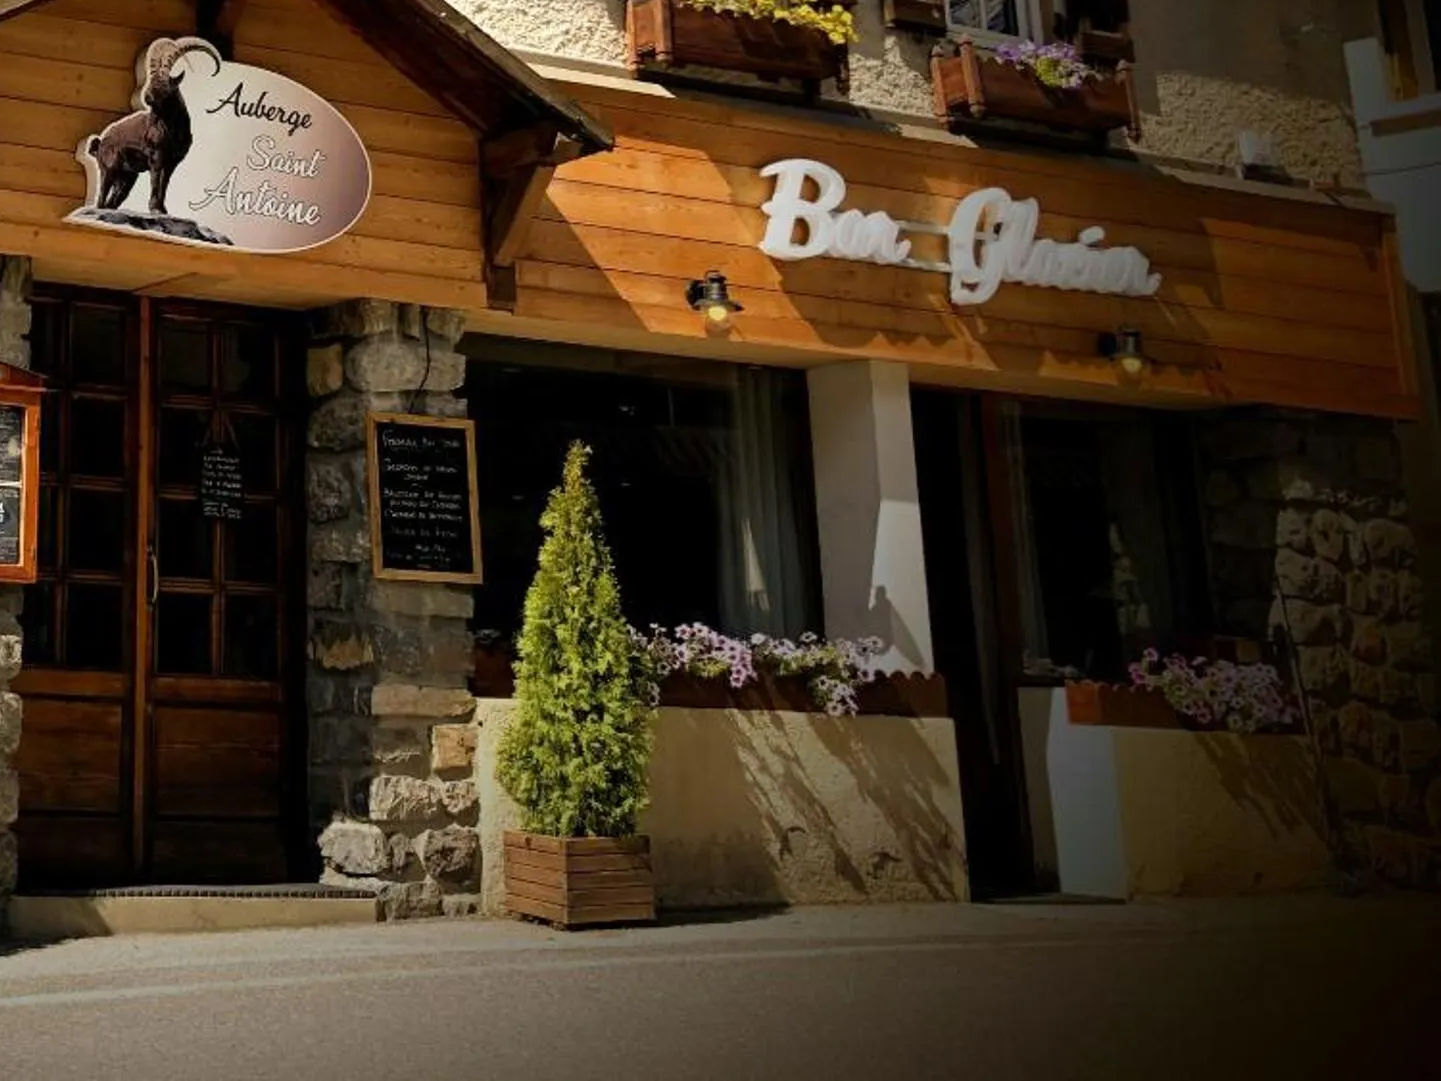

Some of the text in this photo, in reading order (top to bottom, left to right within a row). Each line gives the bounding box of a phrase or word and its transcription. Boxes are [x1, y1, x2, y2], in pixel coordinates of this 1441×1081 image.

[205, 81, 313, 137] Auberge
[247, 133, 326, 180] Saint
[188, 166, 322, 227] Antoine
[759, 157, 912, 266] Bar
